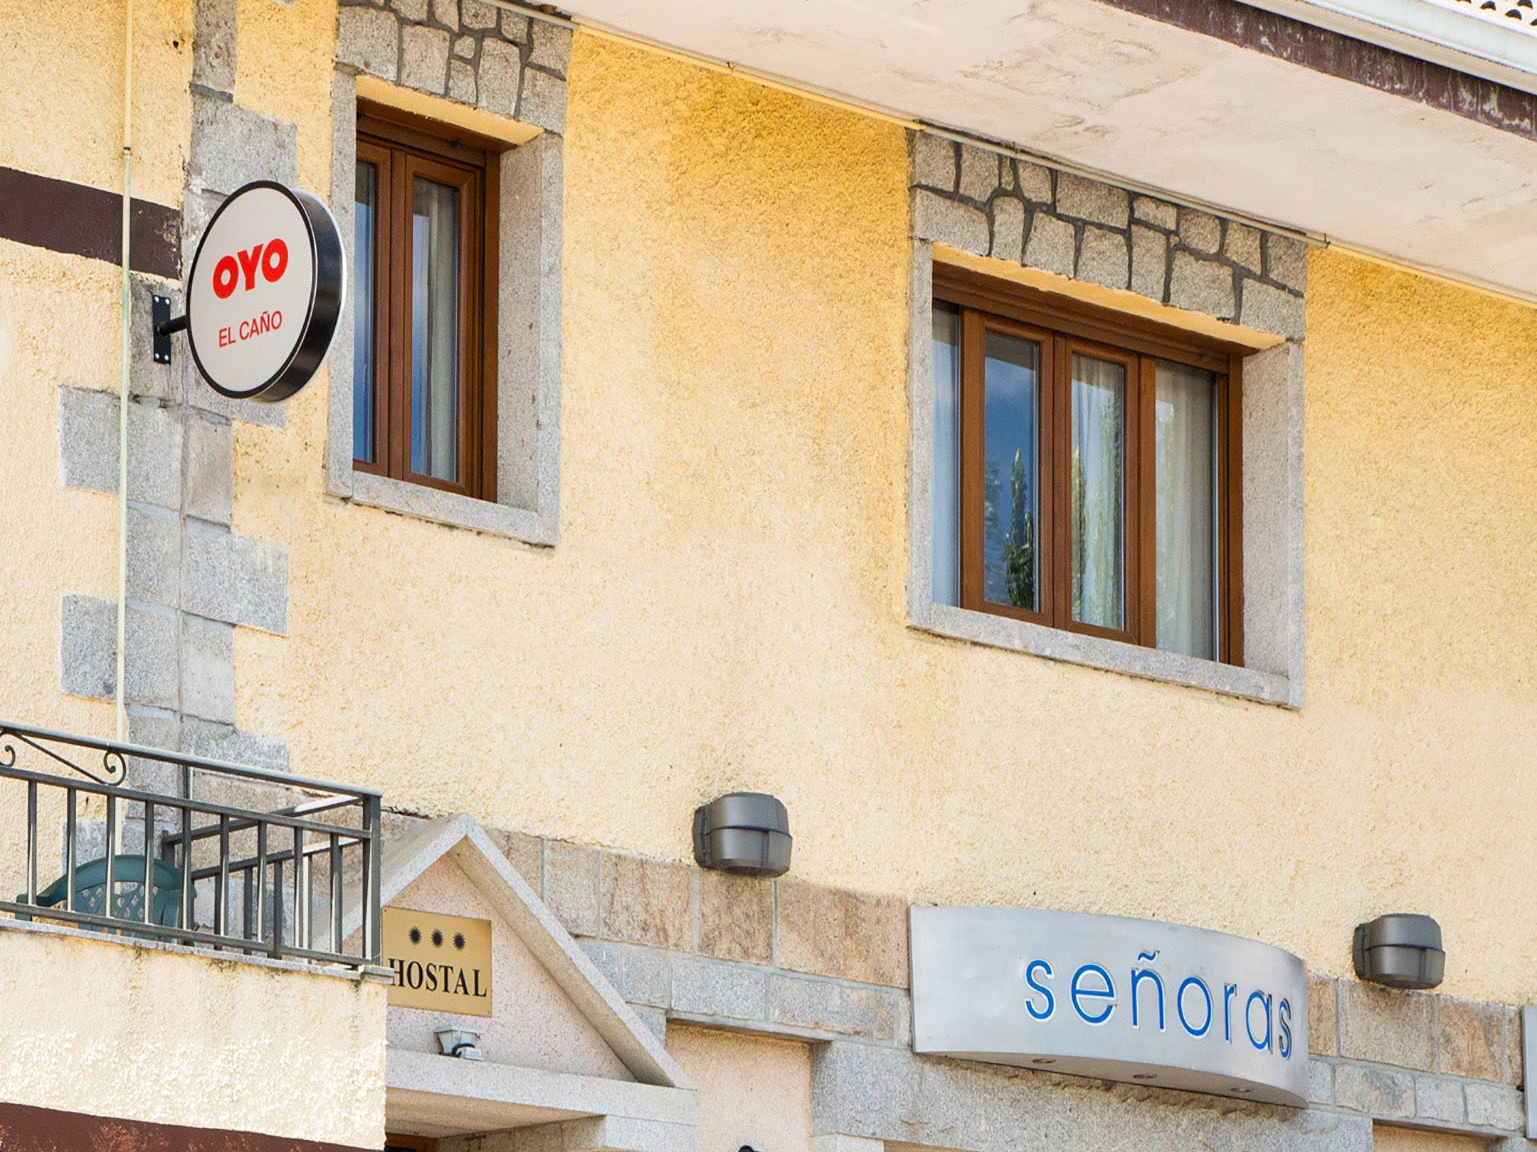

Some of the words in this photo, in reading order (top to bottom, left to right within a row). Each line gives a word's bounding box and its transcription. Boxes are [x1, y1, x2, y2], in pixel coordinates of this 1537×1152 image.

[213, 238, 288, 299] OYO
[218, 327, 236, 348] EL
[239, 310, 283, 341] CAÑO
[387, 957, 488, 998] HOSTAL
[1024, 949, 1292, 1059] señoras
